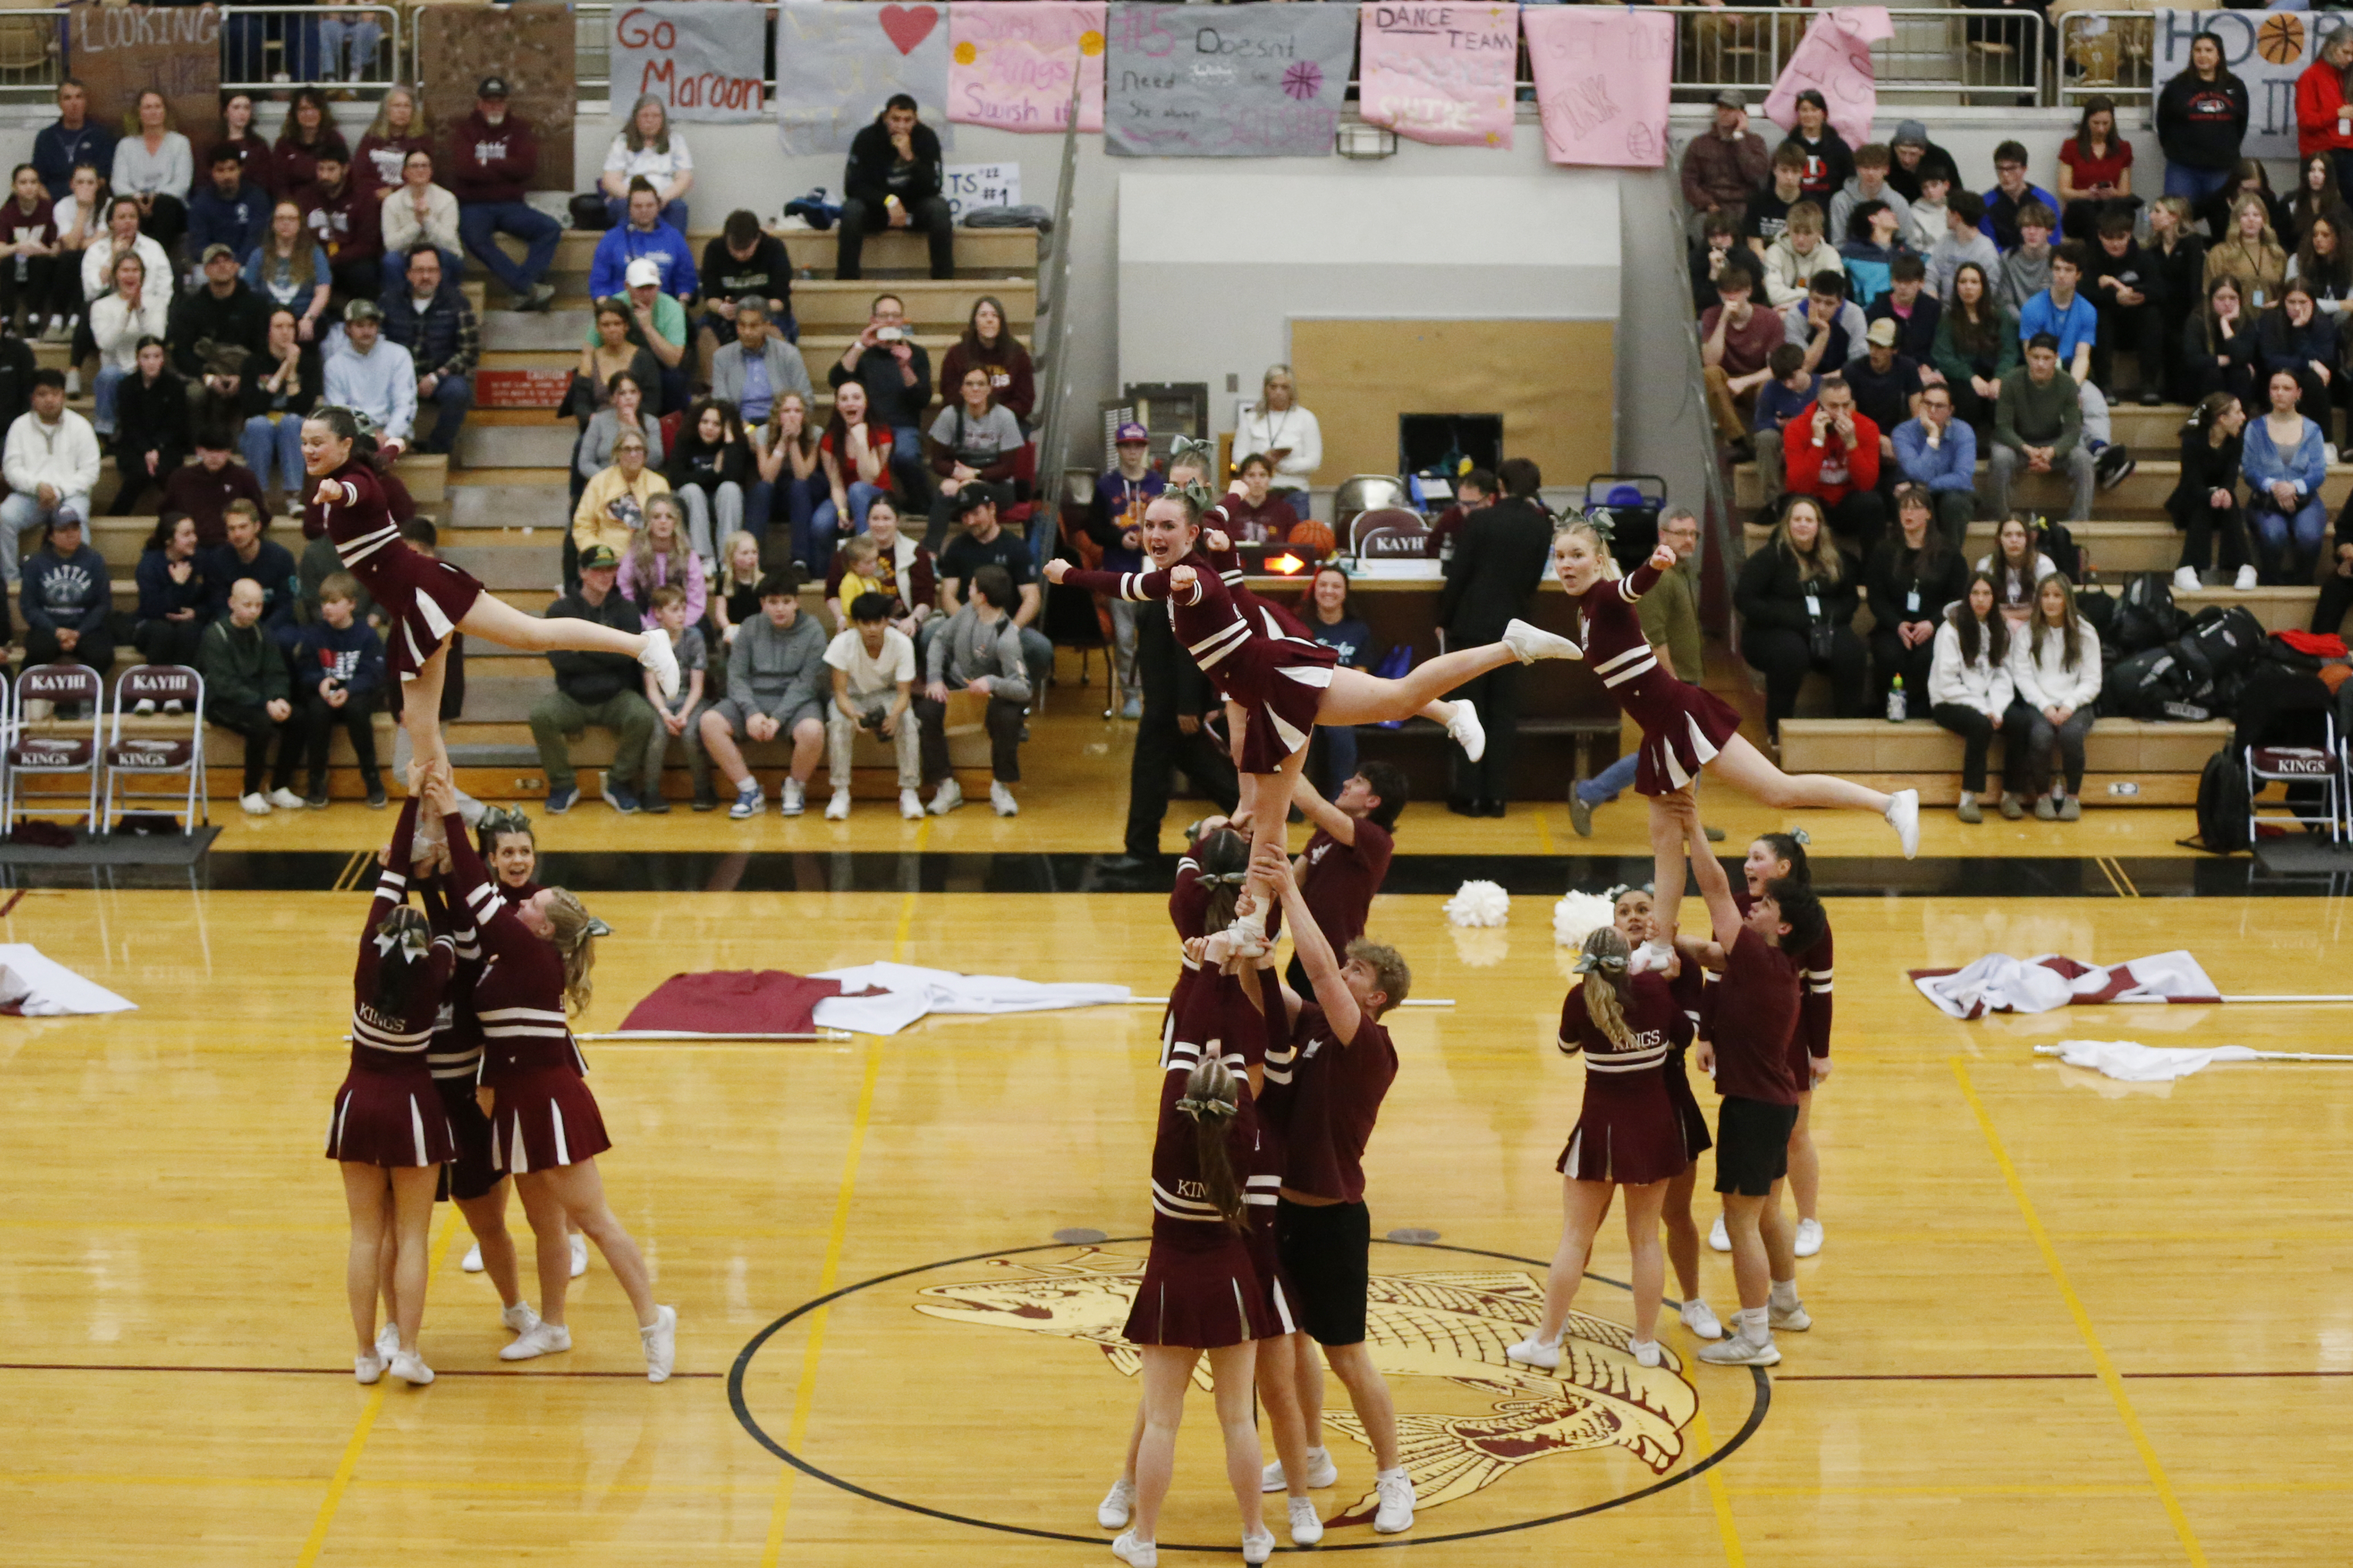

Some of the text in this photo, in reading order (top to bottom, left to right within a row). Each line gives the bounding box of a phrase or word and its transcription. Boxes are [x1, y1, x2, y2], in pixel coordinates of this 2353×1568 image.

[1376, 6, 1454, 28] DANCE
[80, 6, 220, 52] LOOKING
[1445, 29, 1513, 50] TEAM
[641, 59, 764, 110] Maroon
[964, 82, 1038, 121] Swish
[31, 674, 86, 691] KAYHI
[133, 674, 188, 691] KAYHI
[20, 752, 70, 765] KINGS
[118, 752, 167, 765] KINGS
[2278, 759, 2326, 772] KINGS
[1176, 1178, 1207, 1198] KIN
